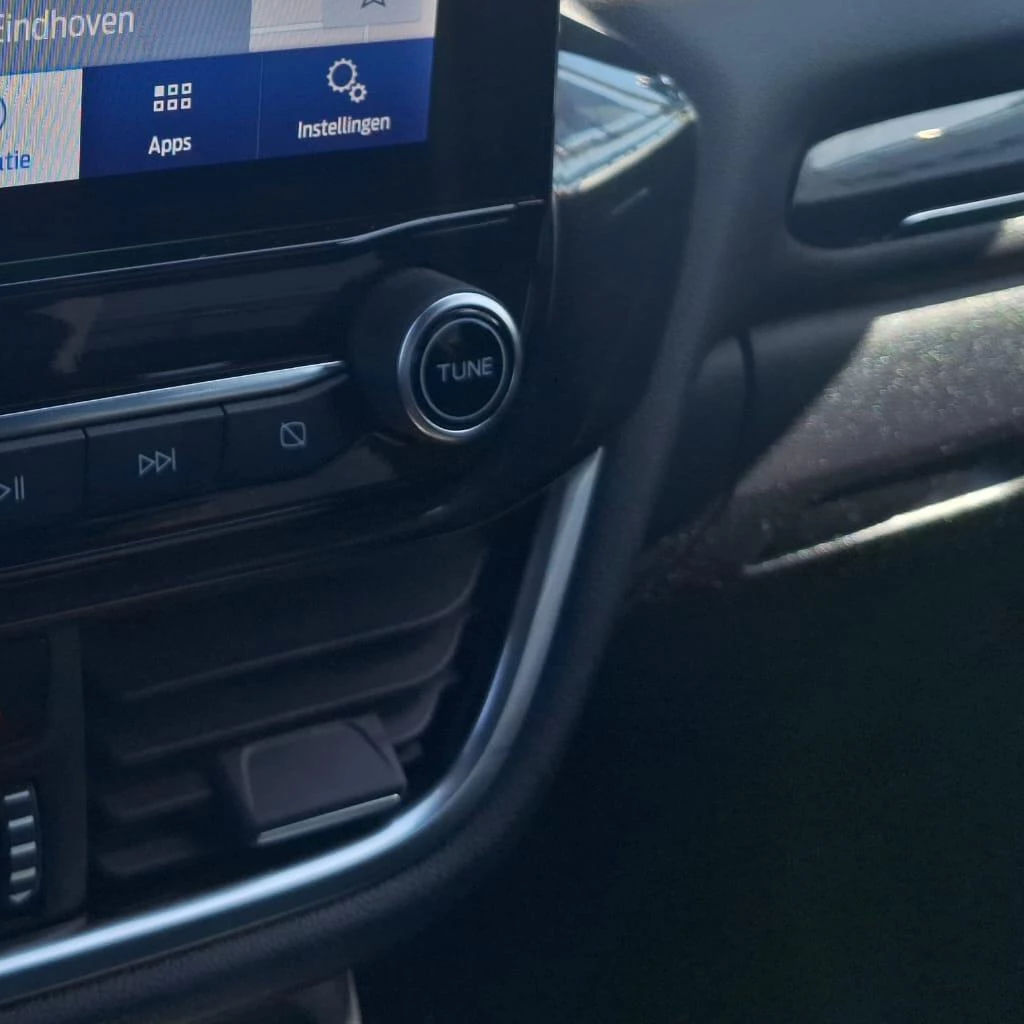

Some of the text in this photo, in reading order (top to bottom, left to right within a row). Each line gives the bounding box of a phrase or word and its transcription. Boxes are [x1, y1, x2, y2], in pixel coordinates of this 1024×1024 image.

[296, 113, 391, 140] Instellingen
[148, 134, 192, 157] Apps
[436, 356, 493, 382] TUNE
